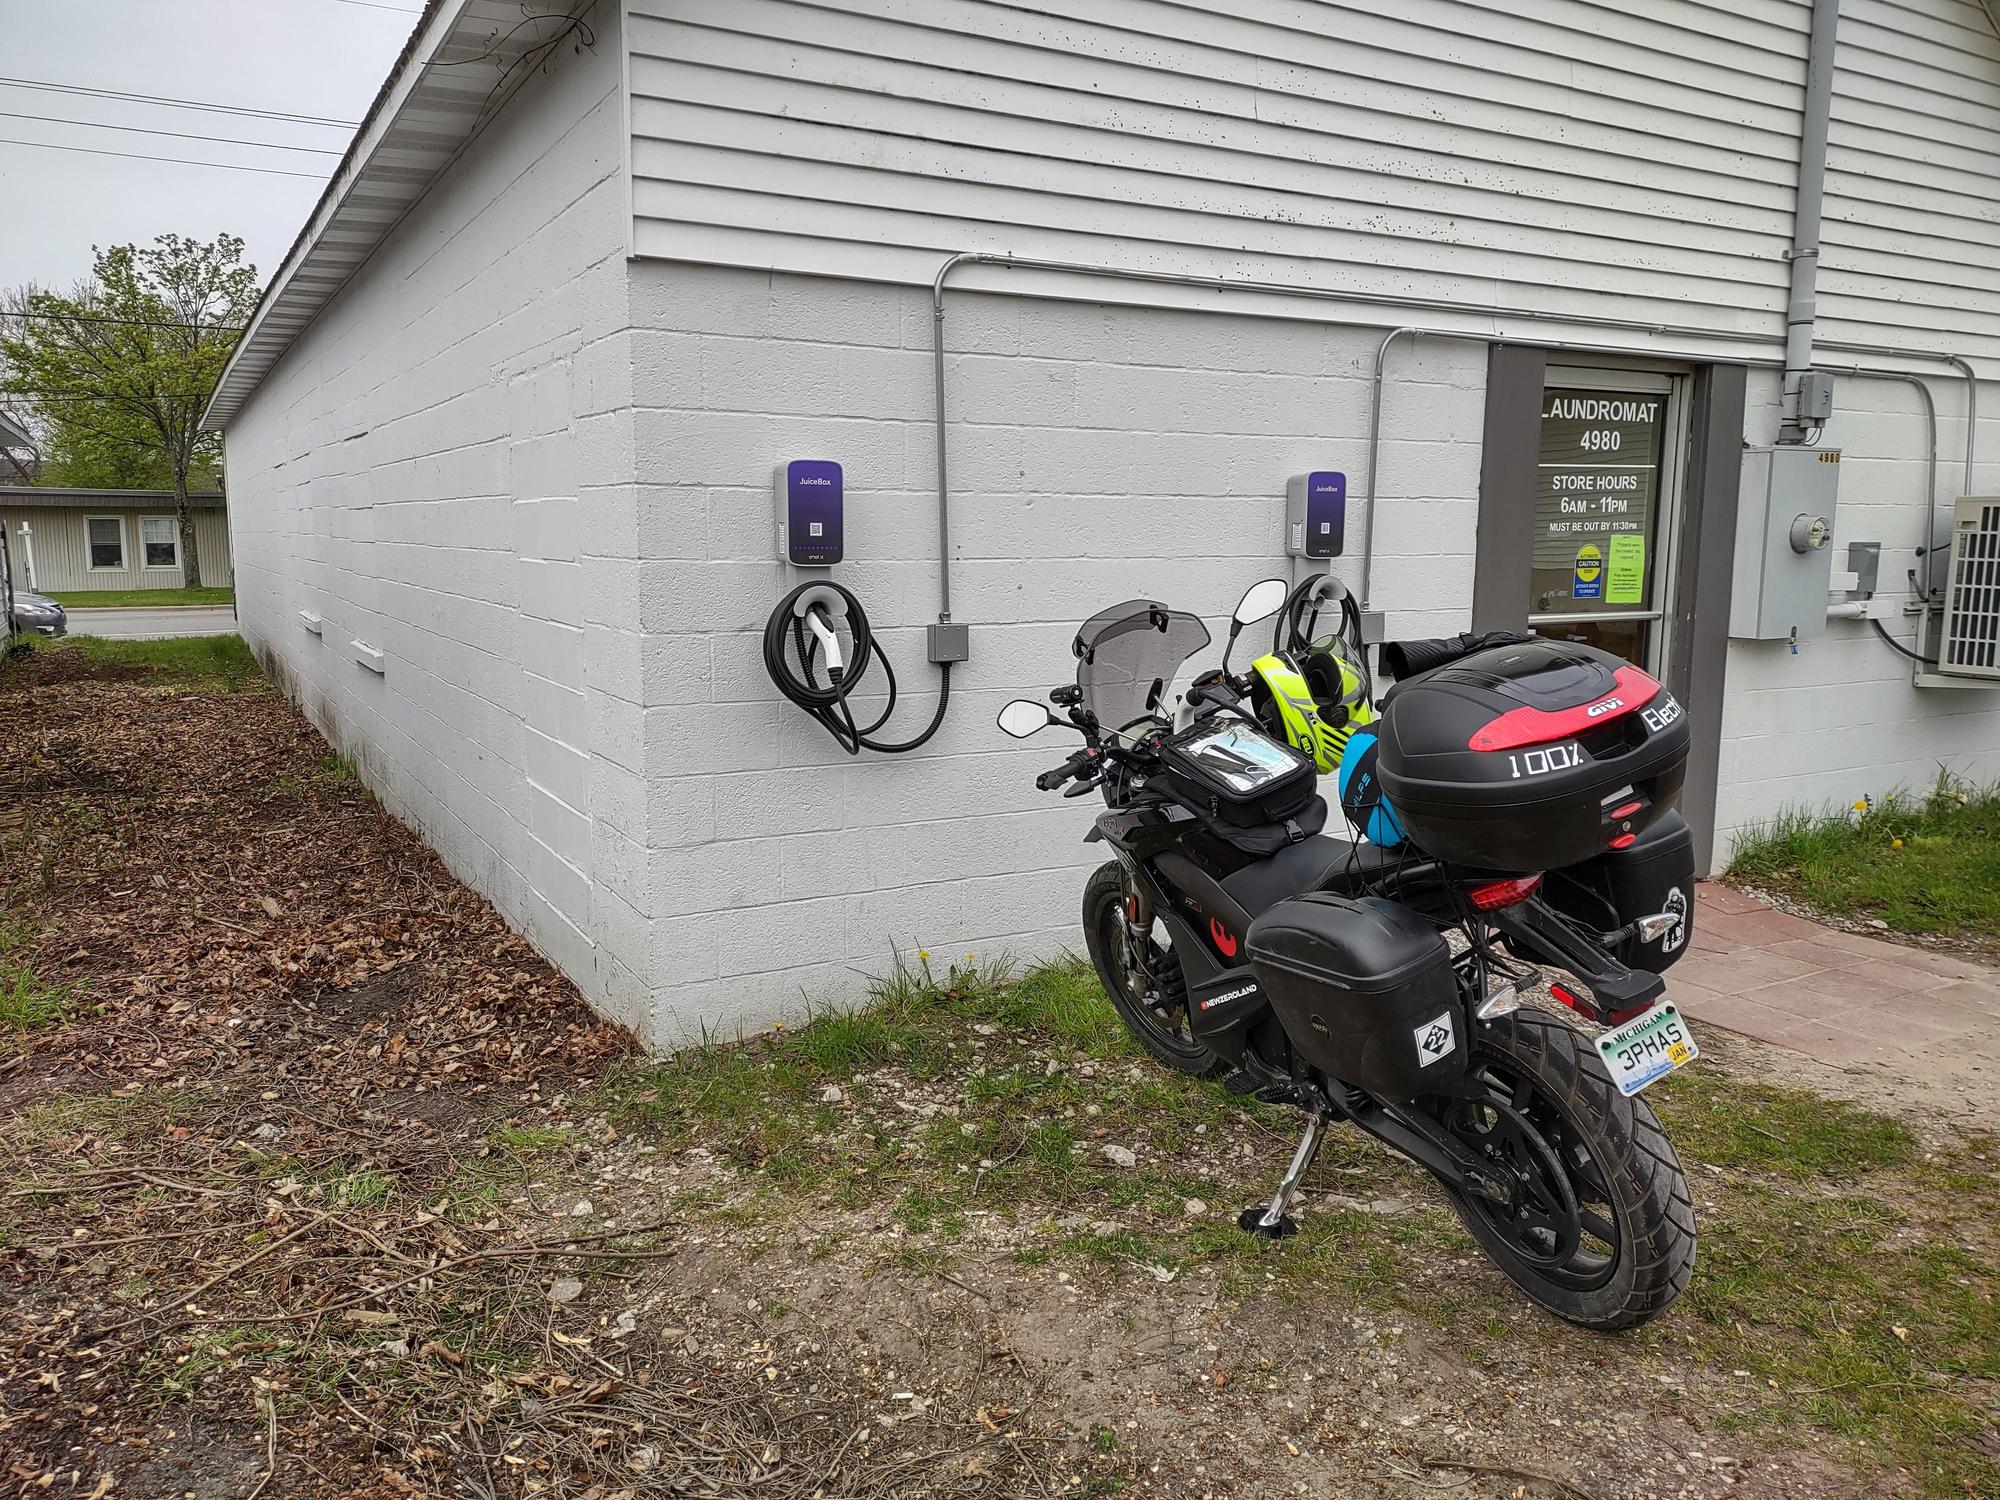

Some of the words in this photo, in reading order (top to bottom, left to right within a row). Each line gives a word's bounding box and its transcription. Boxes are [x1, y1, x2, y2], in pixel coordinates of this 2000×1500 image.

[1580, 430, 1621, 451] 4980
[1818, 452, 1840, 463] 4980
[799, 477, 832, 487] JuiceBox
[1315, 485, 1338, 493] JuiceBox
[1552, 475, 1594, 490] STORE
[1596, 475, 1638, 490] HOURS
[1560, 496, 1587, 514] 6AM
[1600, 496, 1628, 513] 11PM
[1549, 522, 1571, 532] MUST
[1572, 522, 1583, 531] BE
[1583, 522, 1600, 531] OUT
[1600, 522, 1611, 531] BY
[1300, 736, 1314, 755] BEL
[1206, 984, 1258, 1009] NEWZEROLAND
[1612, 1010, 1666, 1046] MICHIGAN
[1428, 1030, 1446, 1051] 22
[1617, 1022, 1683, 1071] 3PHAS
[1672, 1046, 1688, 1061] JAN
